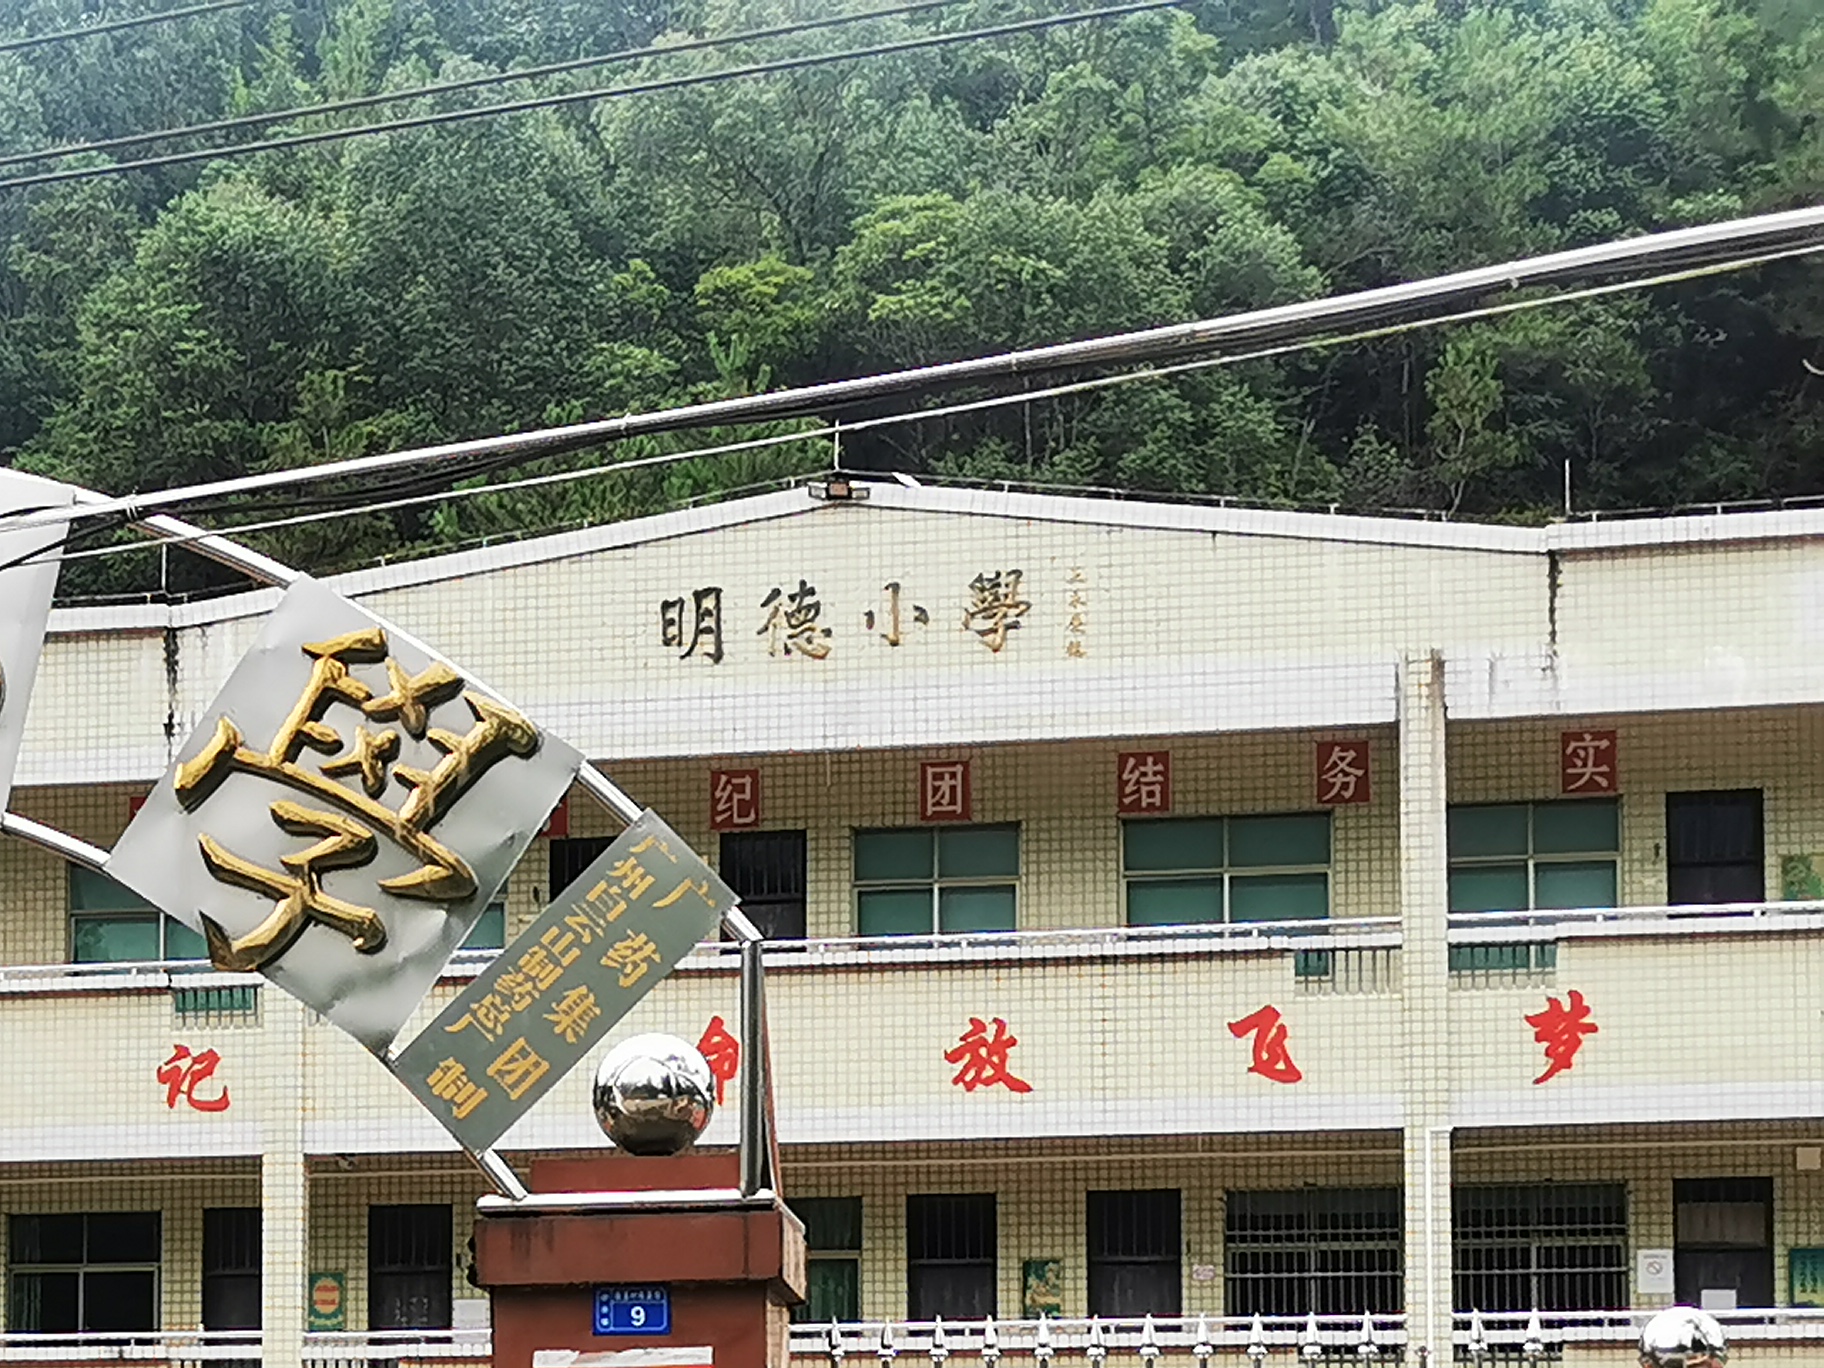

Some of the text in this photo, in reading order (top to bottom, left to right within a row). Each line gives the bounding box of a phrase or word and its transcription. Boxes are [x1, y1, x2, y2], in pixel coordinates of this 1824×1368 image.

[660, 569, 1032, 664] 明德小學
[1123, 756, 1164, 807] 结
[1322, 747, 1365, 800] 务
[1565, 733, 1610, 791] 实
[714, 774, 757, 824] 纪
[926, 764, 963, 816] 团
[444, 835, 677, 1042] 广州白云山制药总厂
[486, 878, 716, 1100] 广药集团
[426, 1056, 488, 1120] 制
[631, 1306, 645, 1326] 9
